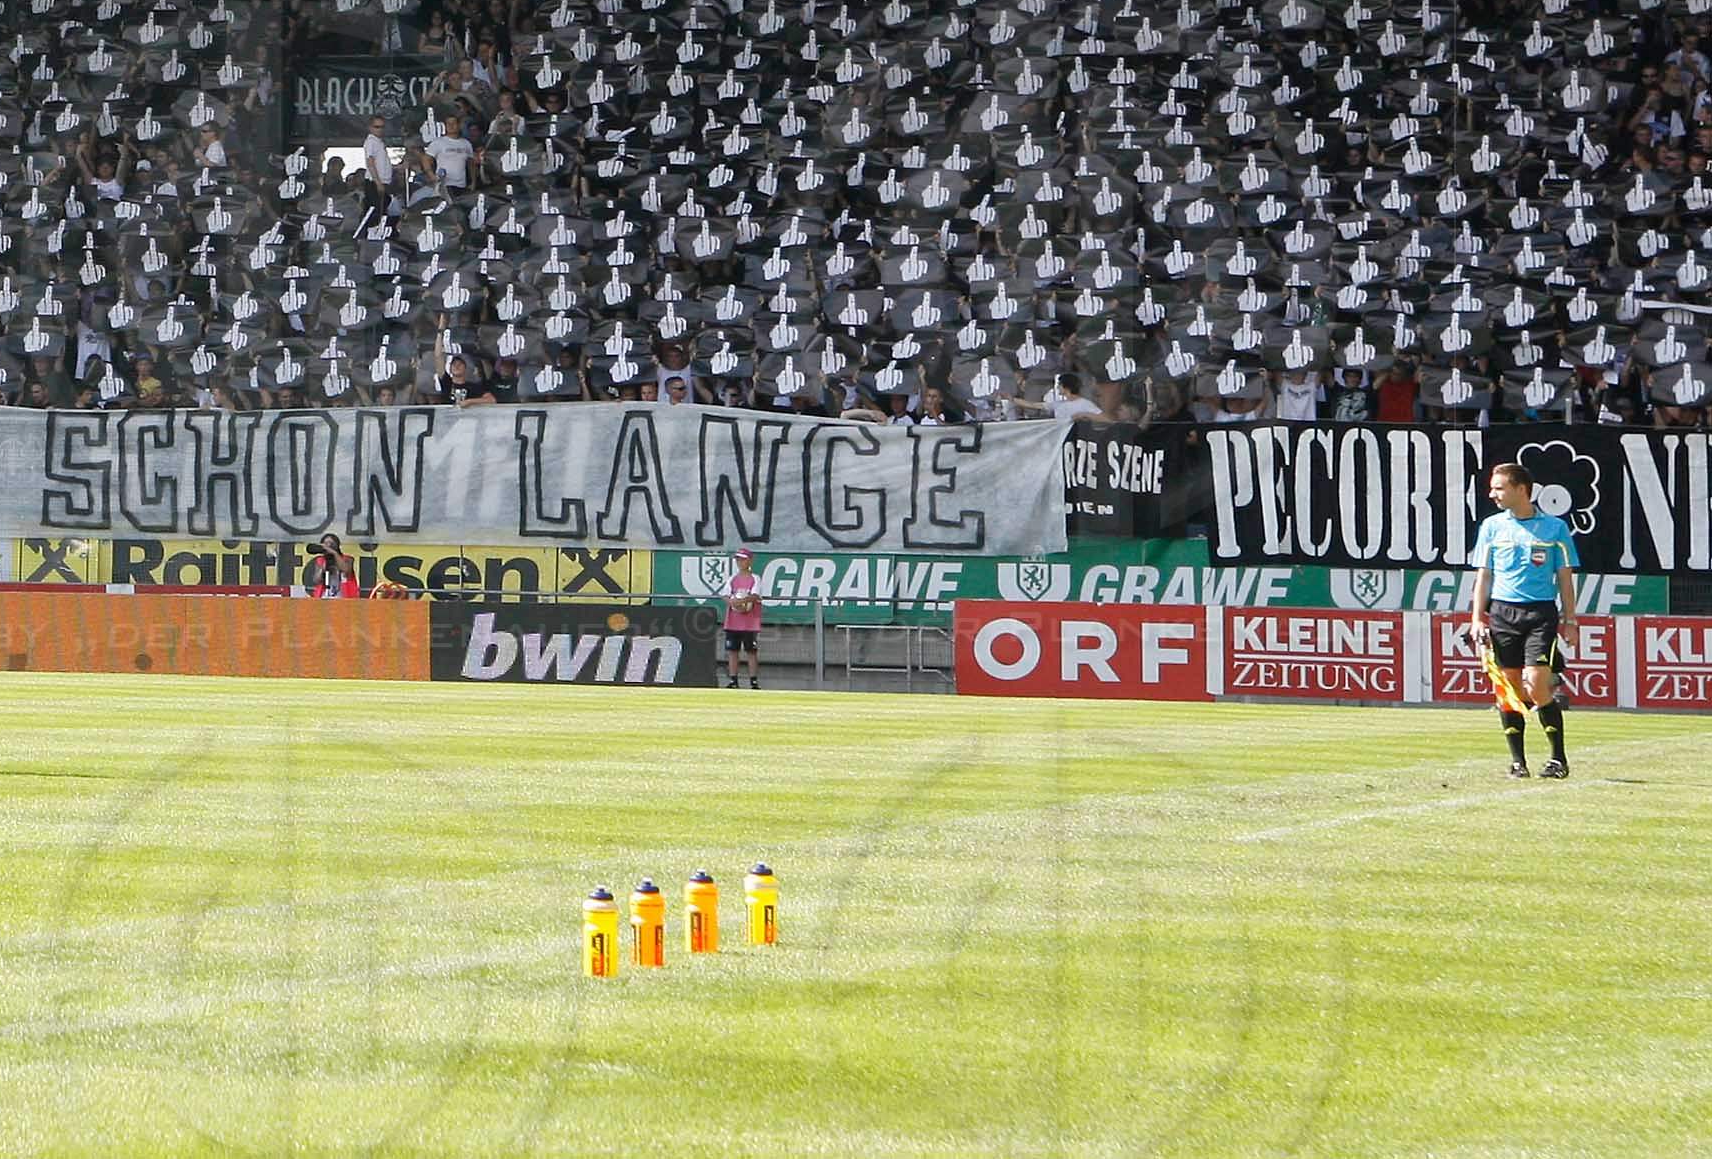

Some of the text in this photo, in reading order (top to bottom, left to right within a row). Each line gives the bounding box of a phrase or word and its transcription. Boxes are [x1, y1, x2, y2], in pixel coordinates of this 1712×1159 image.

[294, 76, 374, 116] BLACK
[40, 407, 434, 536] SCHON
[514, 409, 985, 549] LANGE
[1107, 439, 1165, 495] SZENE
[1206, 424, 1484, 567] PECORE
[760, 557, 963, 611] GRAWE
[1079, 564, 1293, 606] GRAWE
[460, 612, 683, 686] bwin
[973, 617, 1196, 684] ORF
[1233, 615, 1395, 656] KLEINE
[1233, 661, 1397, 693] ZEITUNG
